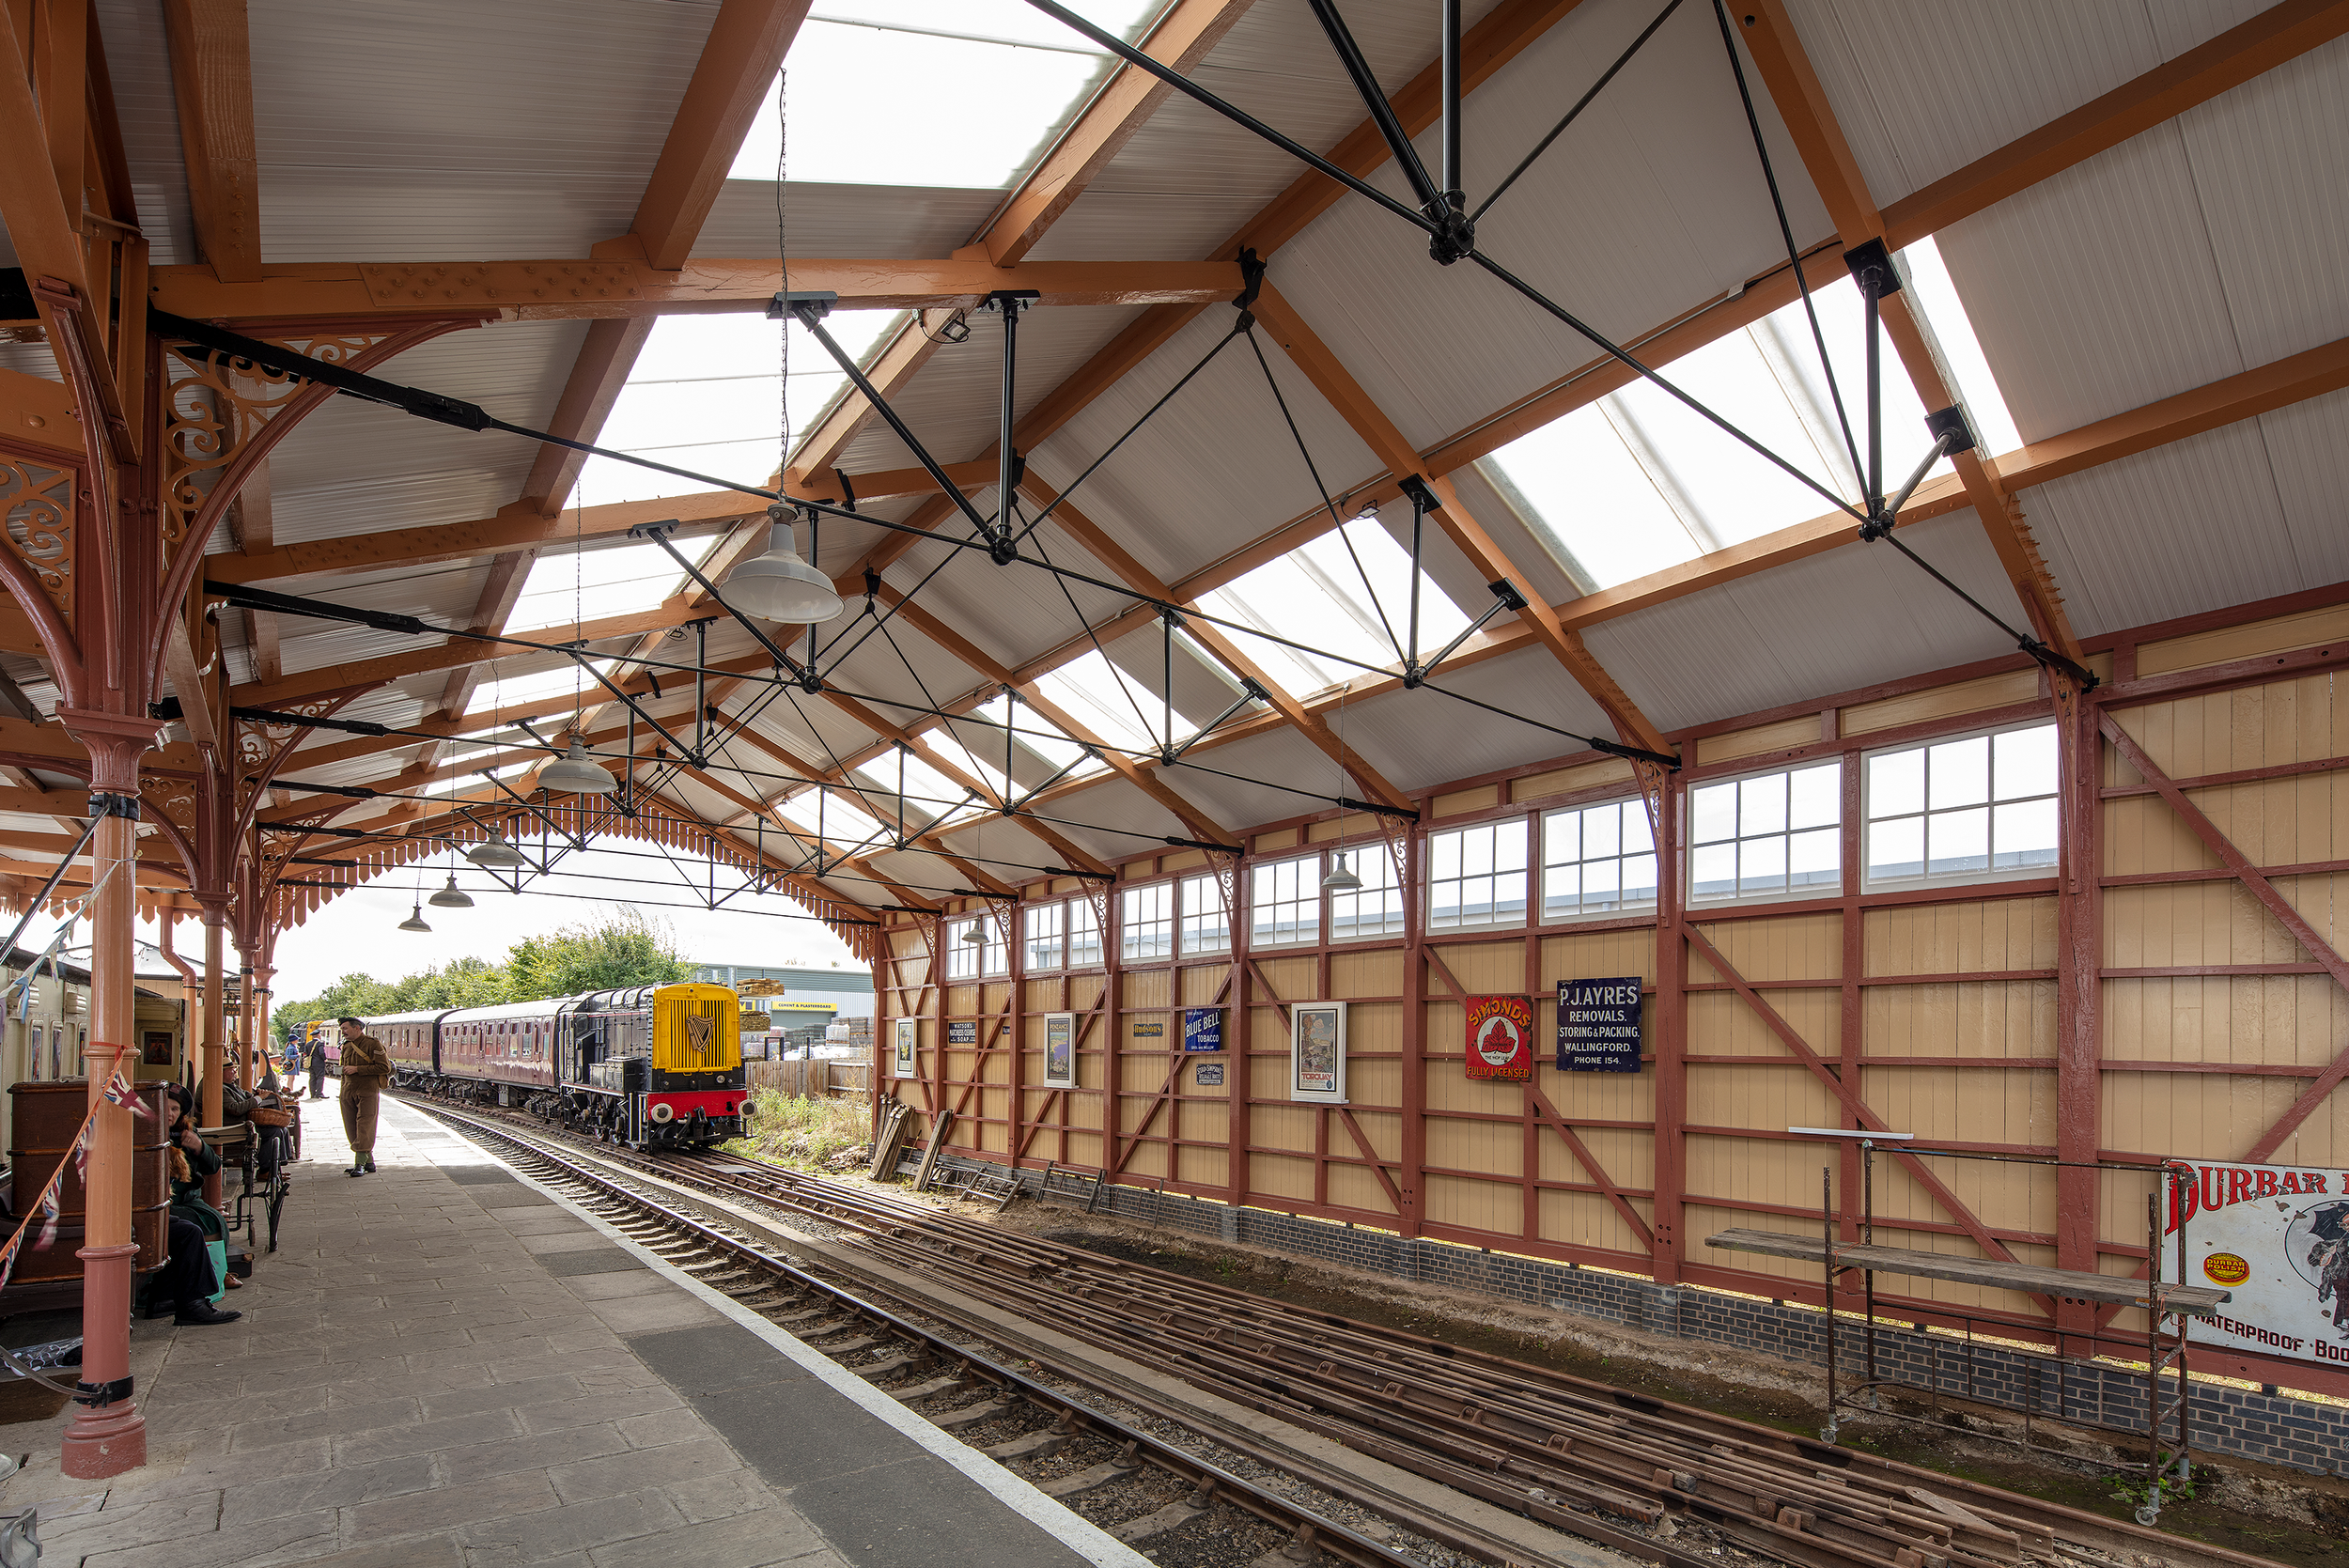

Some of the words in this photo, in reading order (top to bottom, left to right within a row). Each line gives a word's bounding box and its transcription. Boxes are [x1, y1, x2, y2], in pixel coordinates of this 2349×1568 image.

[1469, 1000, 1532, 1027] SIMONDS
[1569, 1009, 1627, 1022] REMOVALS.
[1186, 1018, 1203, 1038] BLUE
[1203, 1011, 1221, 1031] BELL
[1559, 1026, 1593, 1038] STORING
[1598, 1026, 1641, 1038] PACKING.
[1197, 1034, 1220, 1043] TOBACCO
[1564, 1042, 1632, 1052] WALLINGFORD.
[1574, 1056, 1602, 1064] PHONE
[1467, 1065, 1489, 1077] FULLY
[1490, 1067, 1530, 1079] LICENSED
[2164, 1161, 2328, 1236] DURBAR
[2206, 1258, 2246, 1267] DURBAR
[2207, 1264, 2246, 1272] POLISH
